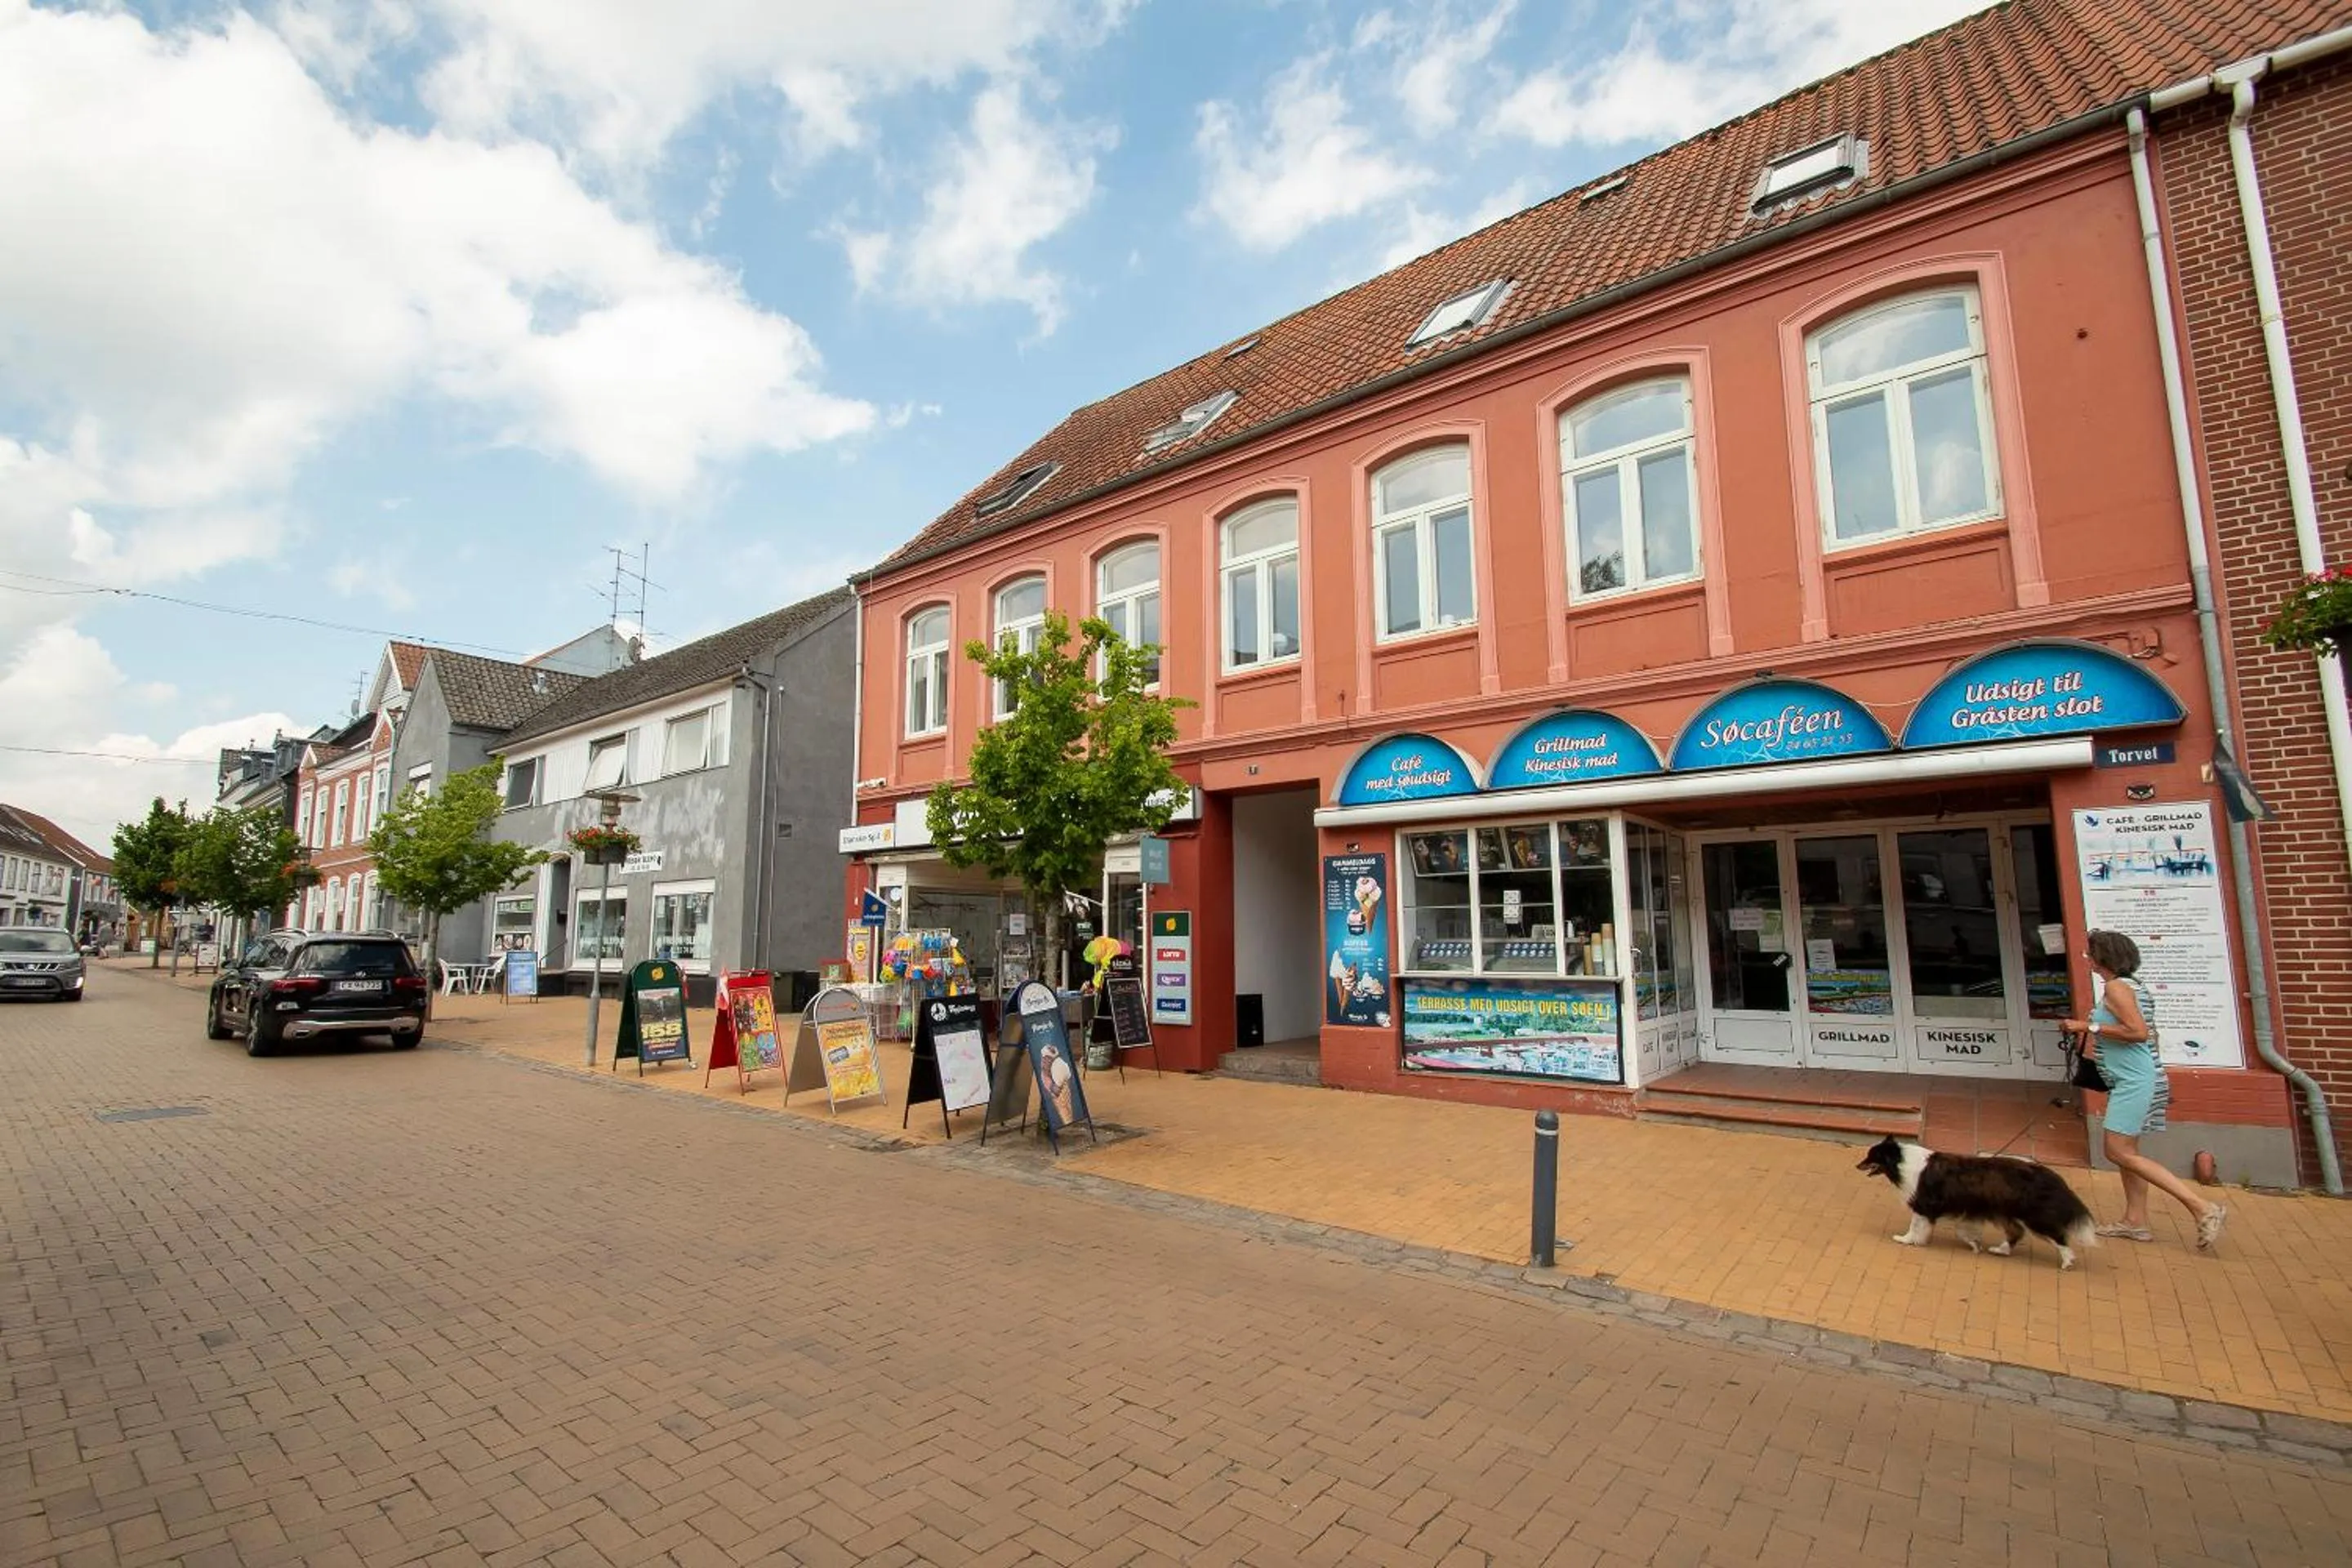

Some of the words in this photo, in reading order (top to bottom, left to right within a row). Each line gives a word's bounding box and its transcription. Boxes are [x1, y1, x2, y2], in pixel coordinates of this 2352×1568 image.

[1965, 679, 2046, 703] Udsigt
[2052, 672, 2082, 692] til
[2055, 695, 2103, 717] slot
[1700, 705, 1843, 749] Søcaféen
[1535, 733, 1607, 754] Grillmad
[1392, 755, 1423, 772] Café
[1525, 754, 1579, 773] Kinesisk
[1584, 752, 1618, 767] mad
[1365, 775, 1393, 790] med
[1395, 769, 1451, 788] søudsigt
[2145, 812, 2203, 822] GRILLMAD
[2115, 824, 2167, 834] KINESISK
[2169, 822, 2194, 831] MAD
[1470, 998, 1493, 1012] MED
[1496, 999, 1535, 1013] UDSIGT
[1539, 1000, 1567, 1015] OVER
[1818, 1031, 1890, 1044] GRILLMAD
[1927, 1031, 1996, 1044] KINESISK
[1946, 1044, 1981, 1054] MAD
